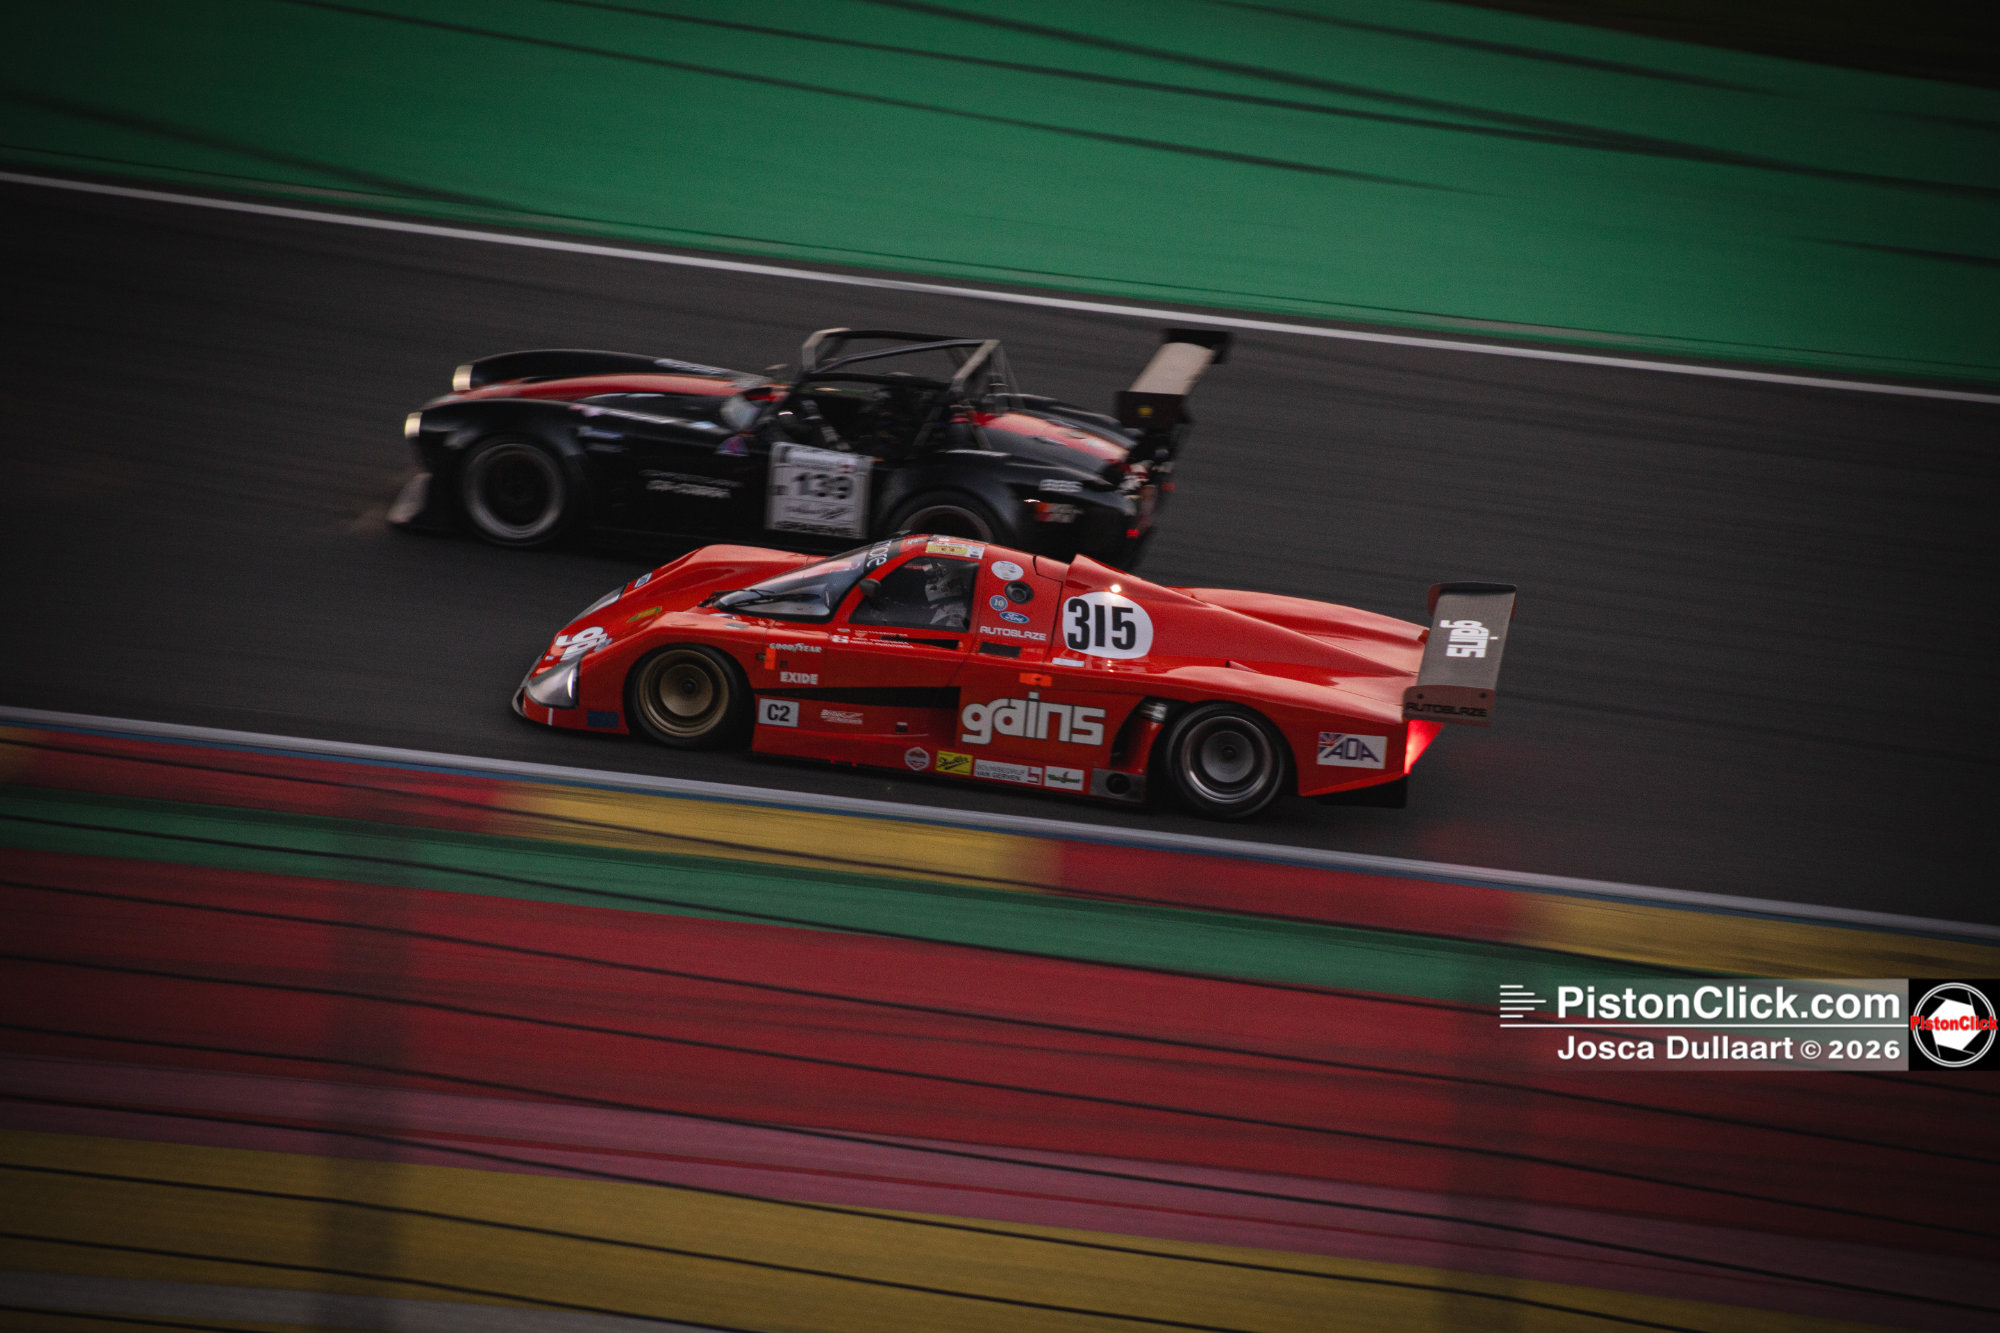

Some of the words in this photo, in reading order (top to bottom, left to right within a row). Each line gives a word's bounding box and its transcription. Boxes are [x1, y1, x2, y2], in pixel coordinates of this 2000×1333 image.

[980, 626, 1047, 641] AUTOBLAZE
[1068, 598, 1136, 651] 315
[1440, 619, 1498, 658] gains
[779, 671, 819, 685] EXIDE
[768, 703, 790, 722] C2
[961, 691, 1106, 746] gains
[1405, 702, 1488, 718] AUTOBLAZE
[1323, 738, 1381, 763] ADA
